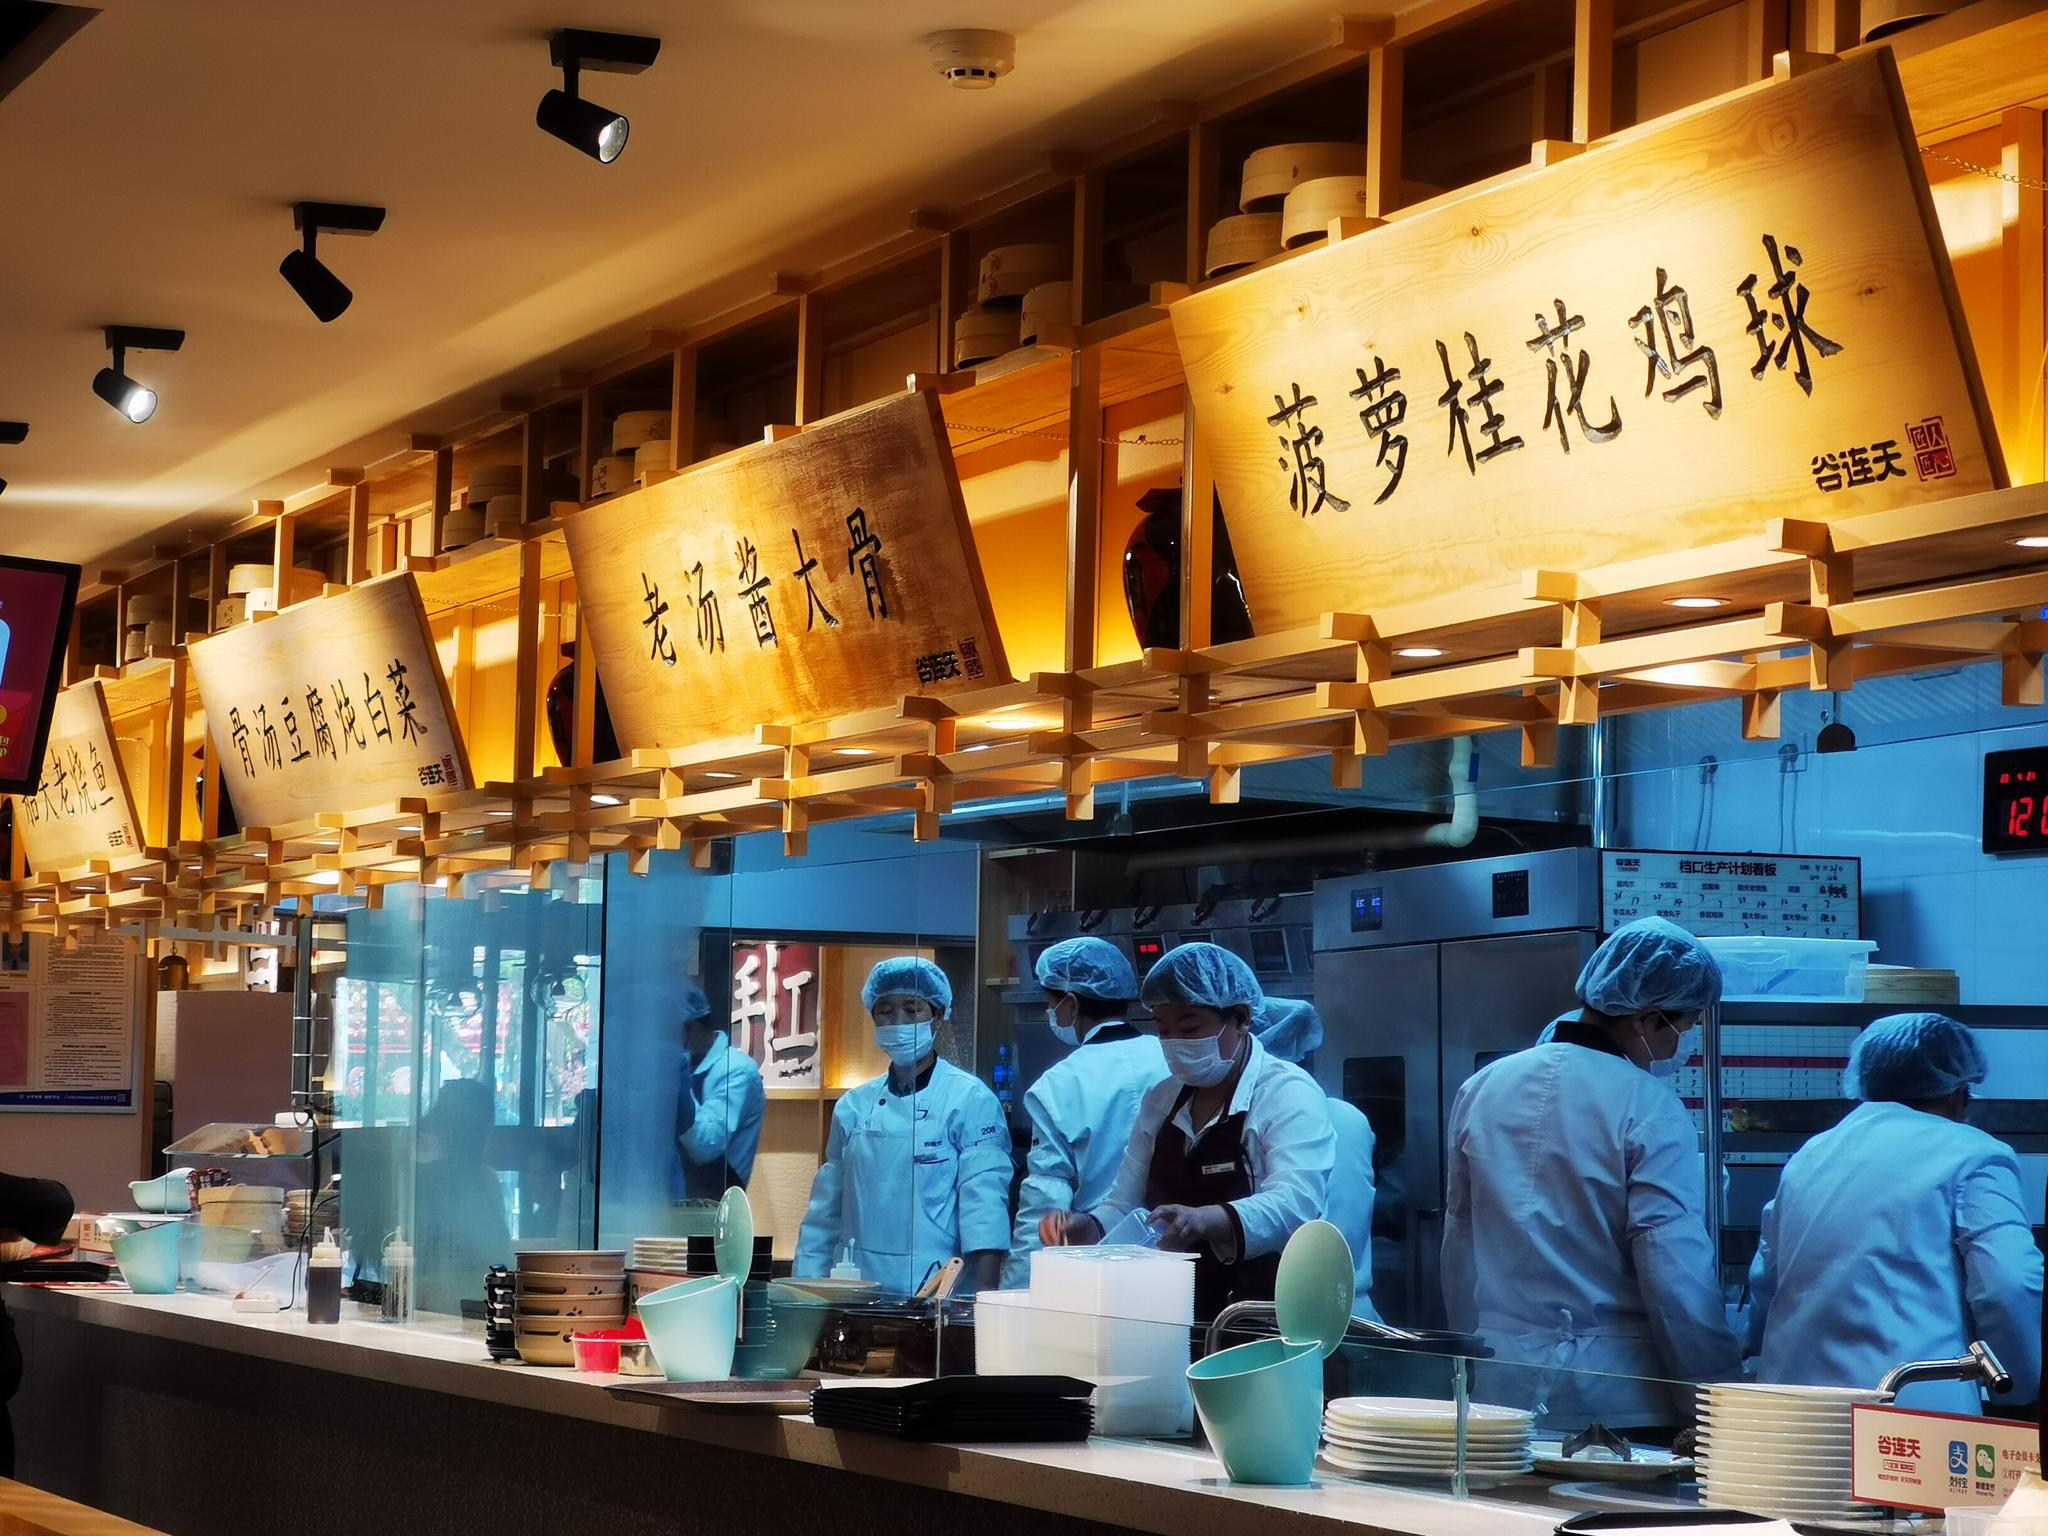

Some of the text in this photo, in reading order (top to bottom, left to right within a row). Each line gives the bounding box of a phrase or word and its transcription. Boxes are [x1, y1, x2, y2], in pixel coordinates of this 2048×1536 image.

[1267, 234, 1844, 518] 菠萝桂花鸡球
[1811, 440, 1907, 493] 谷连天
[641, 506, 888, 668] 老汤酱大骨
[229, 658, 429, 780] 骨汤豆腐炖白菜
[1679, 859, 1777, 876] 档口生产计划看板
[1877, 1434, 1922, 1459] 谷连天
